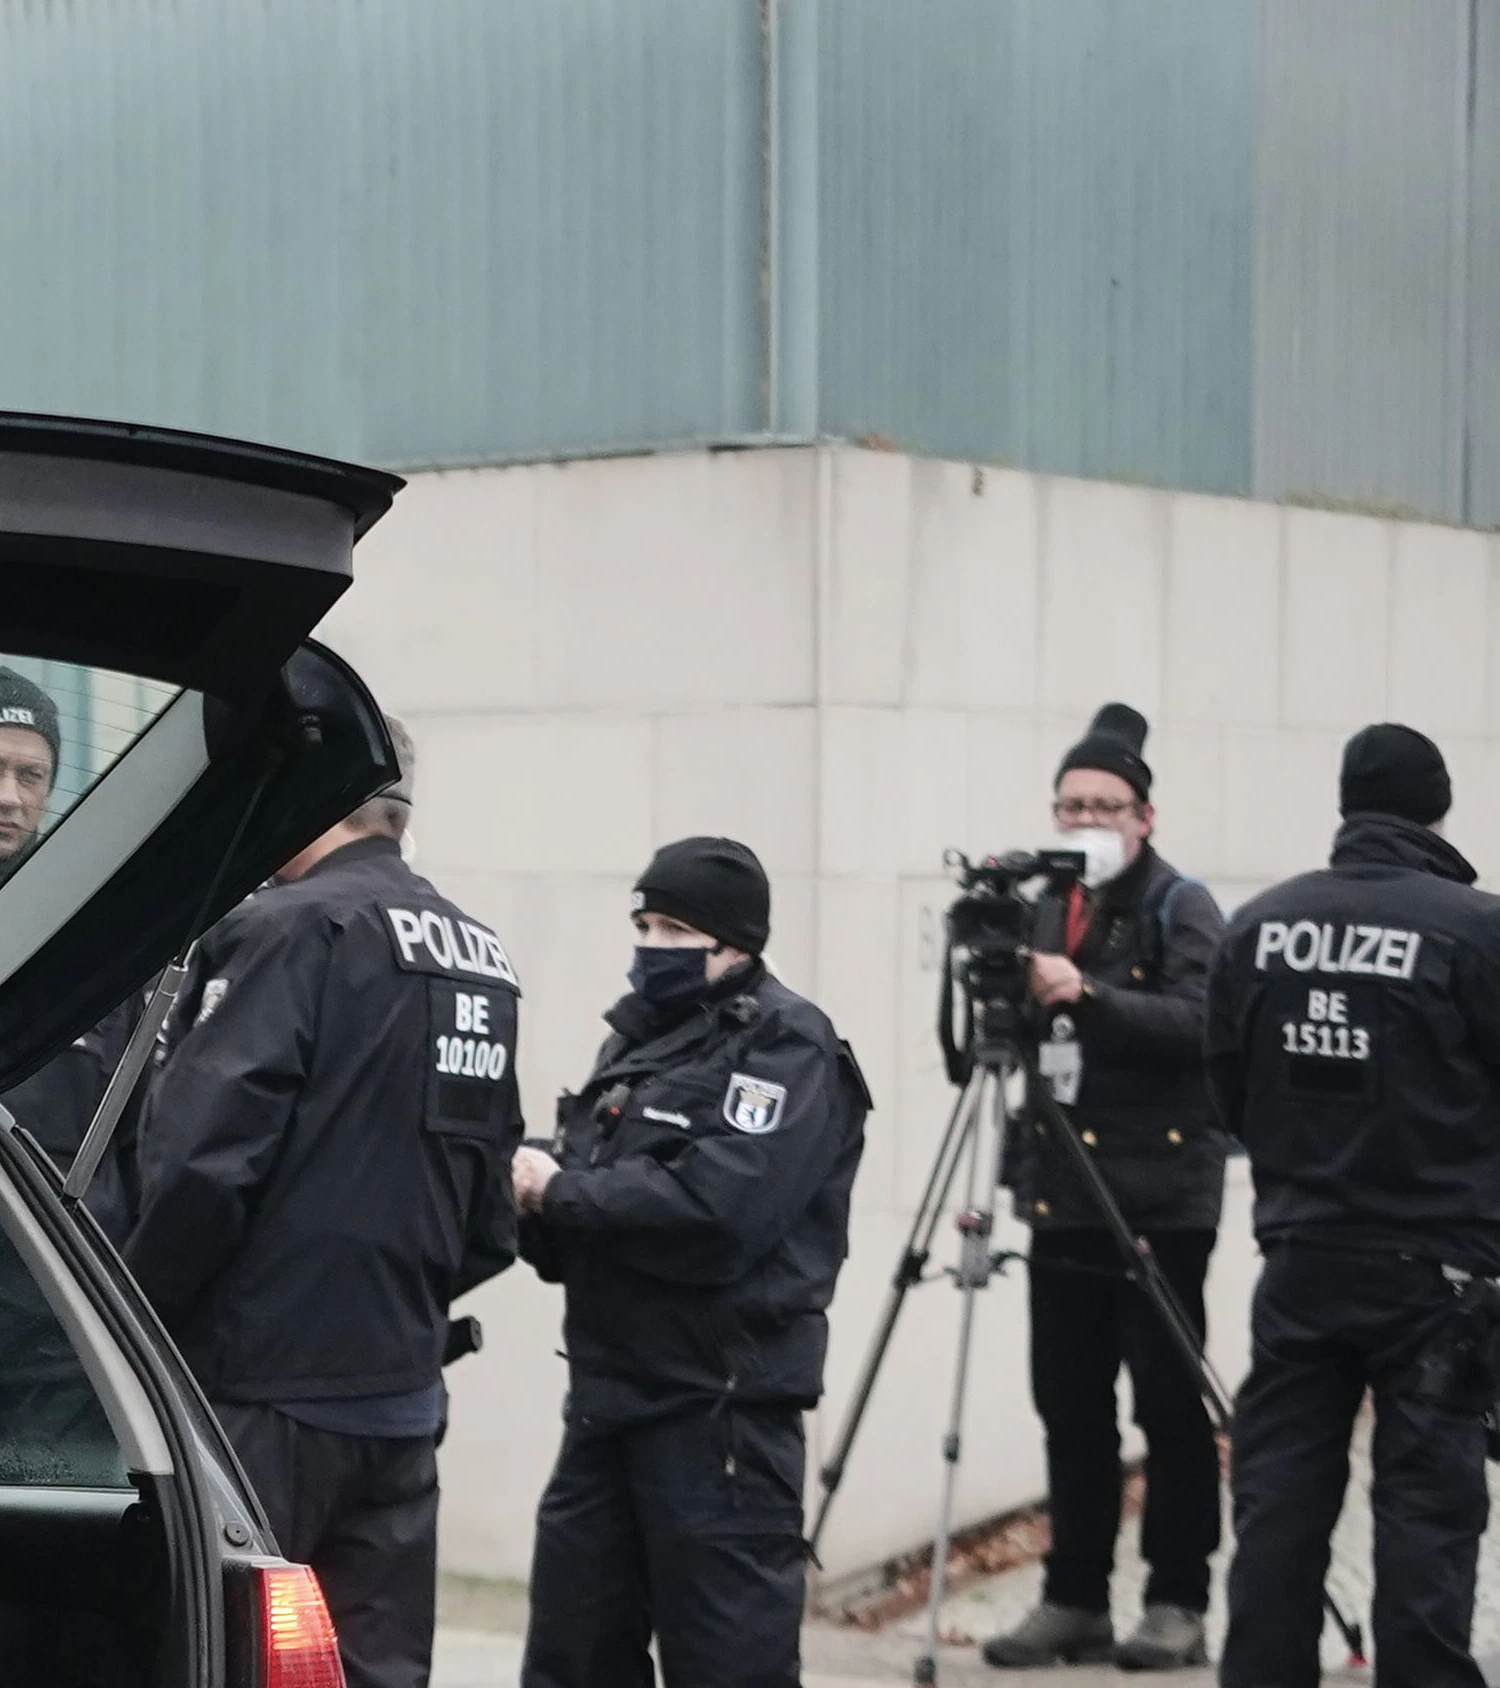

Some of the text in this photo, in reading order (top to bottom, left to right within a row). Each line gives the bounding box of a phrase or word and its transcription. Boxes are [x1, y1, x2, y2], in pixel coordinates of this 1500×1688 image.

[387, 908, 518, 986] POLIZEI
[1255, 920, 1422, 979] POLIZEI
[456, 992, 489, 1034] BE
[1308, 988, 1348, 1023] BE
[436, 1035, 506, 1080] 10100
[1282, 1022, 1370, 1060] 15113
